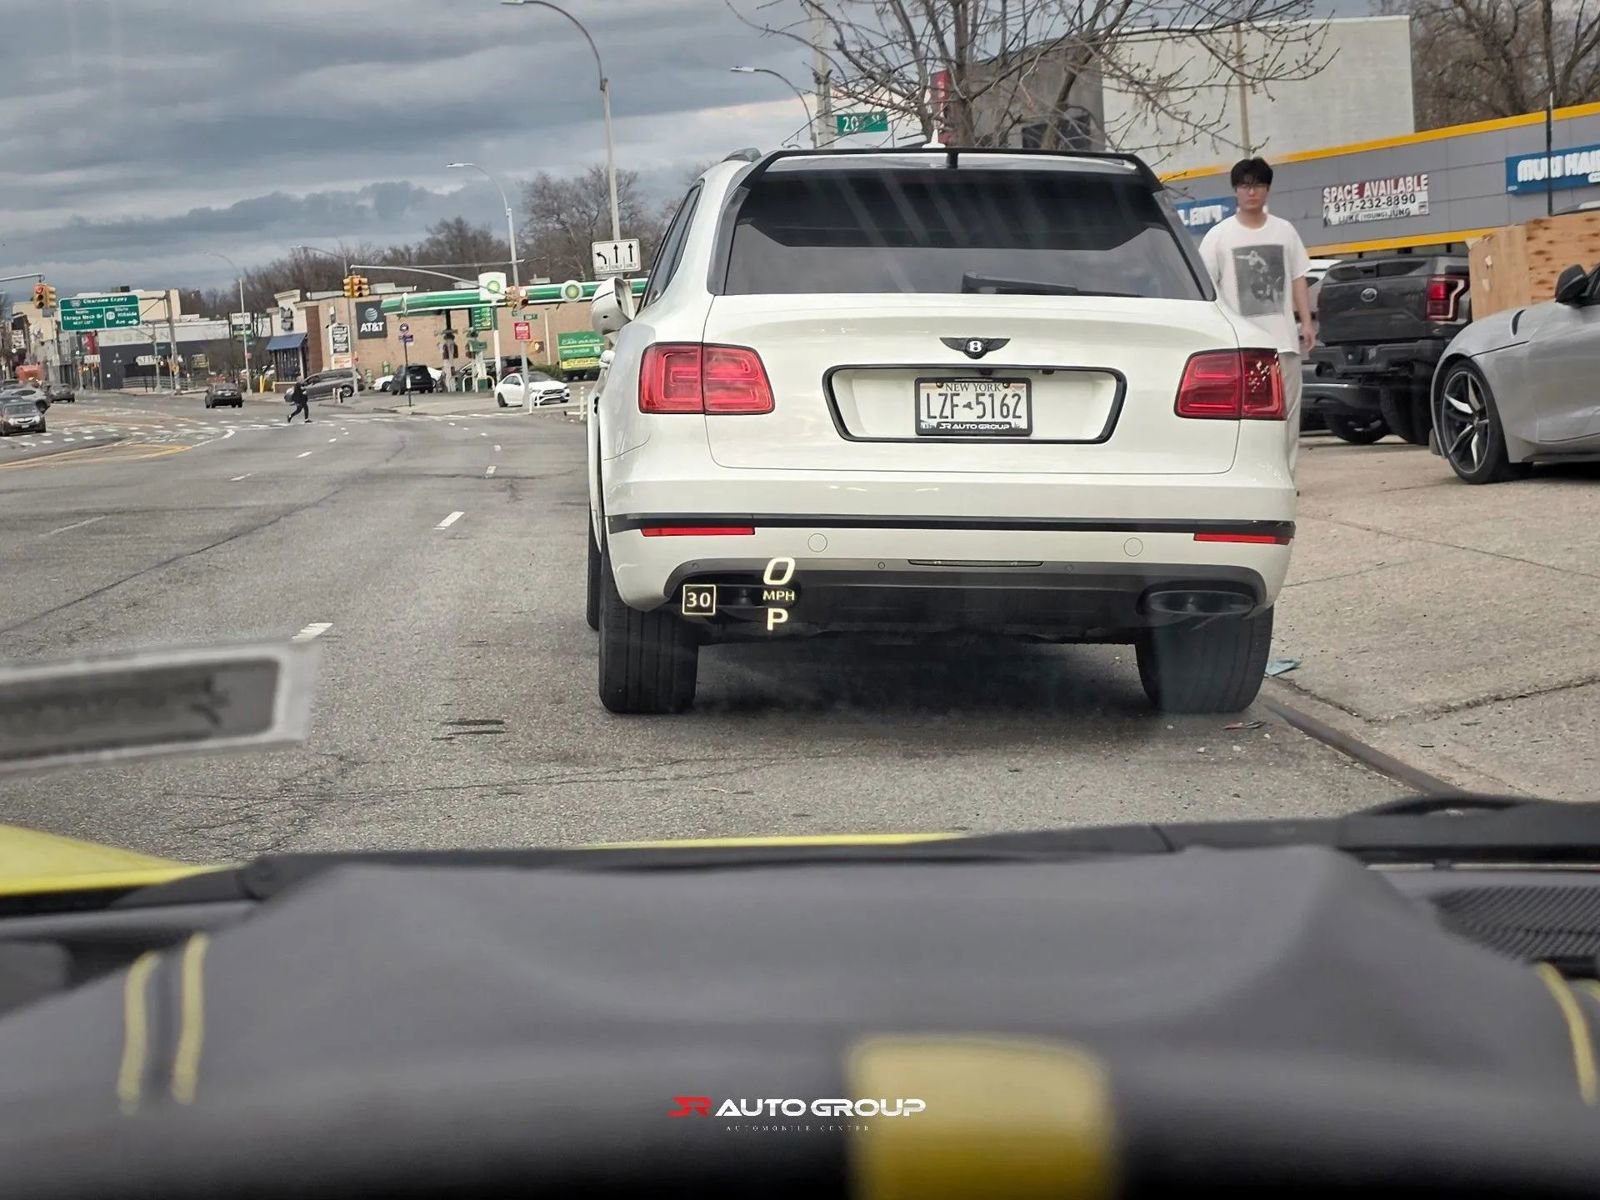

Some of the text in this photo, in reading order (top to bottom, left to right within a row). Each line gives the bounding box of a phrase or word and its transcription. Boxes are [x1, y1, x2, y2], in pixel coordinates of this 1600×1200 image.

[1323, 174, 1429, 203] SPACE AVAILABLE
[1334, 193, 1416, 213] 917-232-8890
[360, 321, 385, 333] AT&T
[945, 383, 1001, 392] NEW YORK
[926, 392, 1022, 419] LZF 5162
[762, 557, 796, 586] 0
[686, 592, 711, 608] 30
[762, 590, 795, 601] MPH
[766, 608, 789, 631] P
